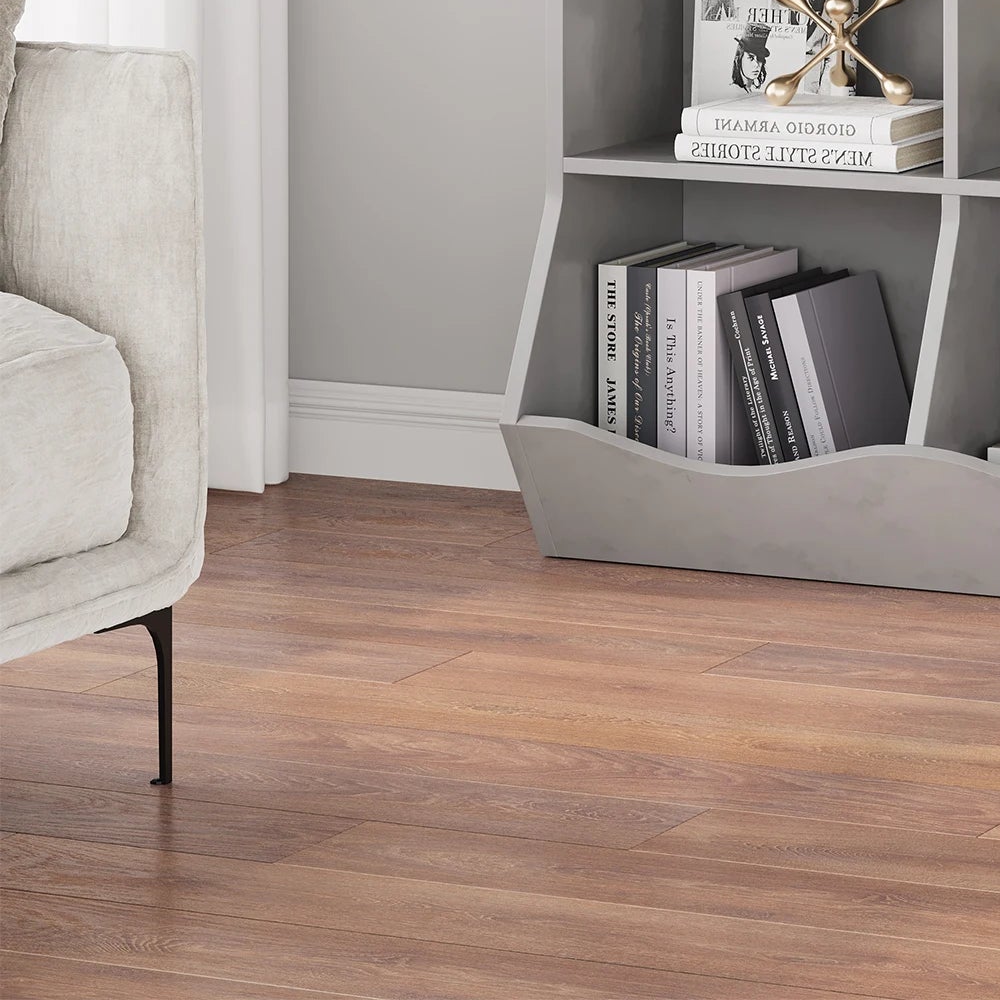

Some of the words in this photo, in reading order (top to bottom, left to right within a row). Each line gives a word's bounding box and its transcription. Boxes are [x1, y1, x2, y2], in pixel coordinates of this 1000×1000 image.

[606, 280, 616, 310] THE
[634, 311, 643, 332] The
[666, 318, 676, 330] Is
[729, 311, 741, 339] Cochran
[606, 313, 616, 362] STORE
[631, 336, 643, 375] Origins
[666, 334, 676, 363] This
[744, 348, 753, 366] Print
[749, 368, 756, 376] of
[631, 377, 643, 389] of
[752, 377, 760, 391] Age
[606, 378, 616, 425] JAMES
[634, 392, 643, 411] Our
[664, 367, 676, 434] Anything?
[759, 405, 766, 413] in
[752, 419, 758, 428] of
[761, 414, 774, 444] Thought
[697, 436, 703, 446] OF
[755, 429, 767, 457] Twilight
[769, 445, 776, 453] of
